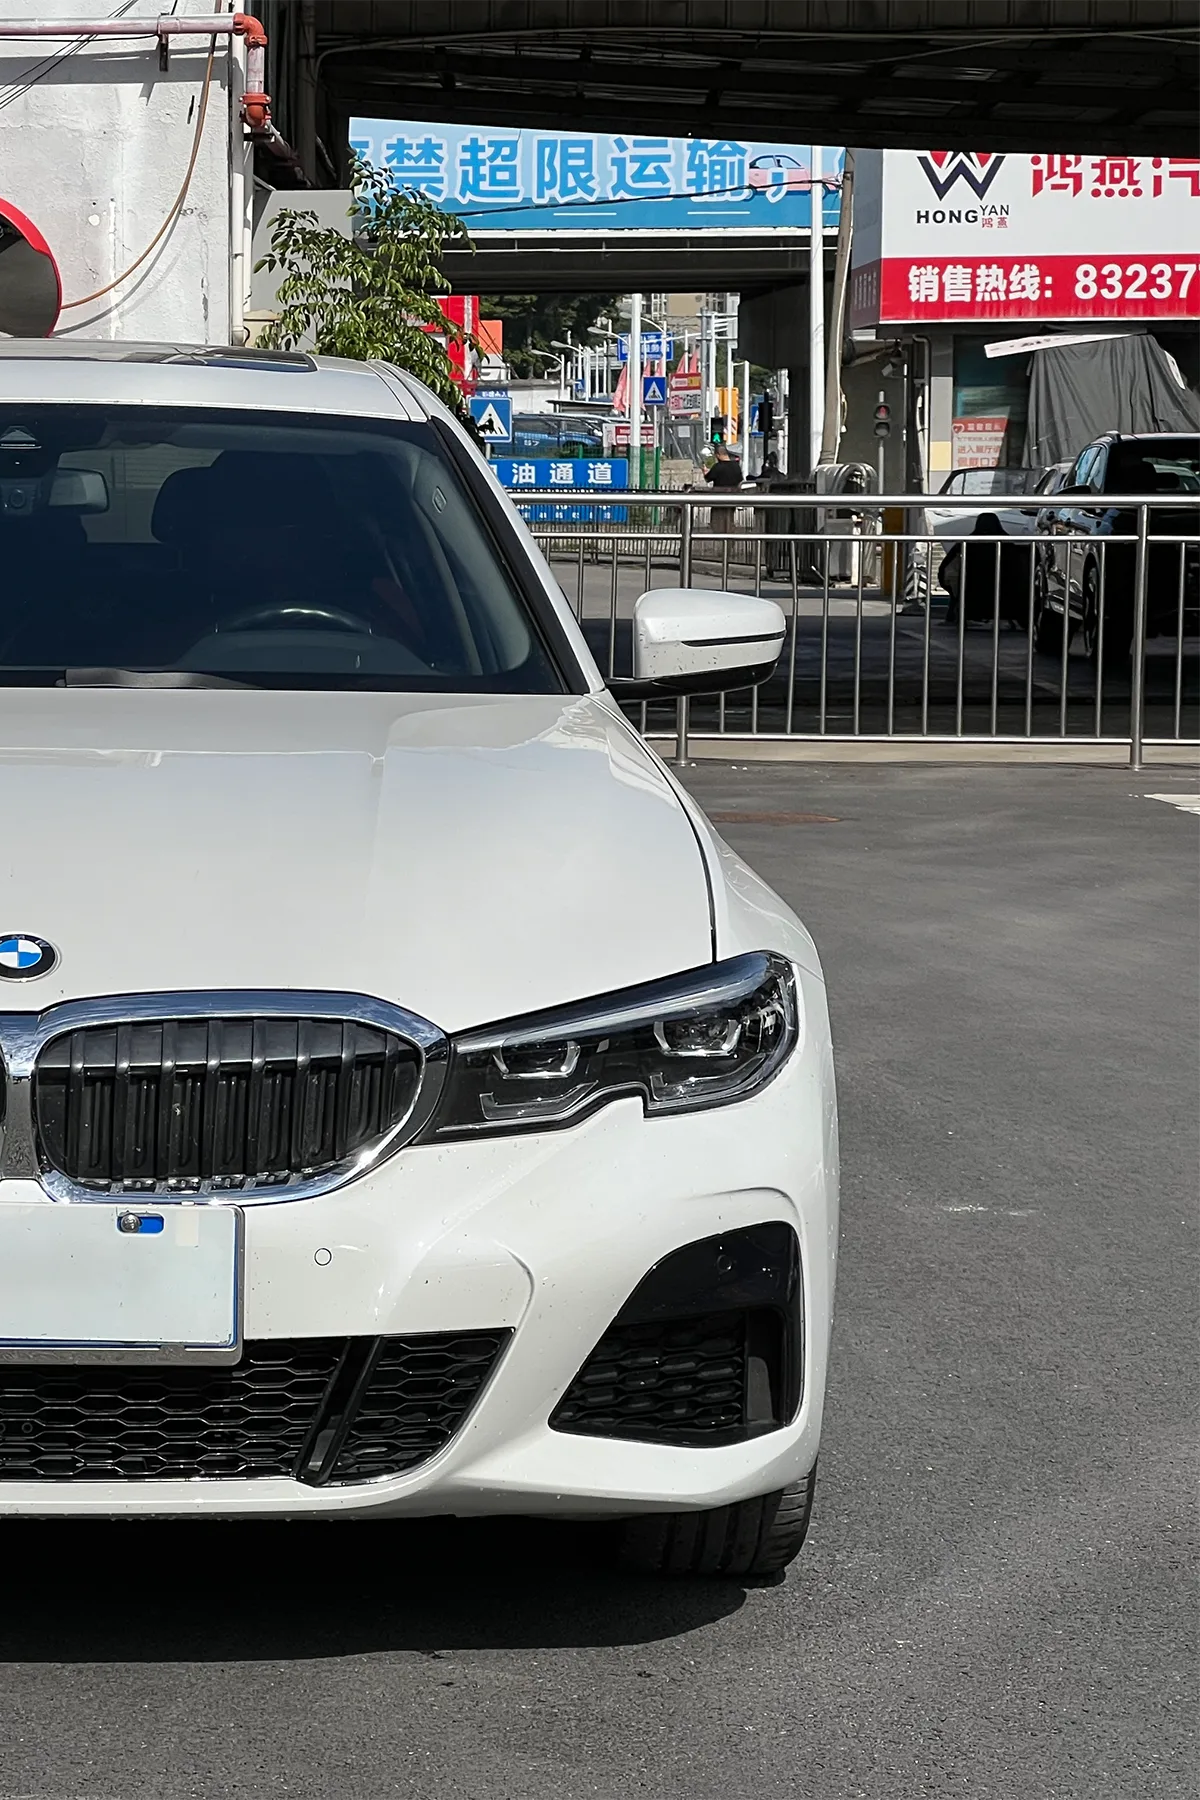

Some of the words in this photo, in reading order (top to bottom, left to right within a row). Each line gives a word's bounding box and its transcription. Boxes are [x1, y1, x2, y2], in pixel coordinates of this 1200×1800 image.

[349, 136, 785, 201] 禁超限运输，
[916, 209, 978, 224] HONG
[979, 204, 1009, 217] YAN
[1074, 263, 1200, 300] 83237
[490, 462, 613, 484] 油通道
